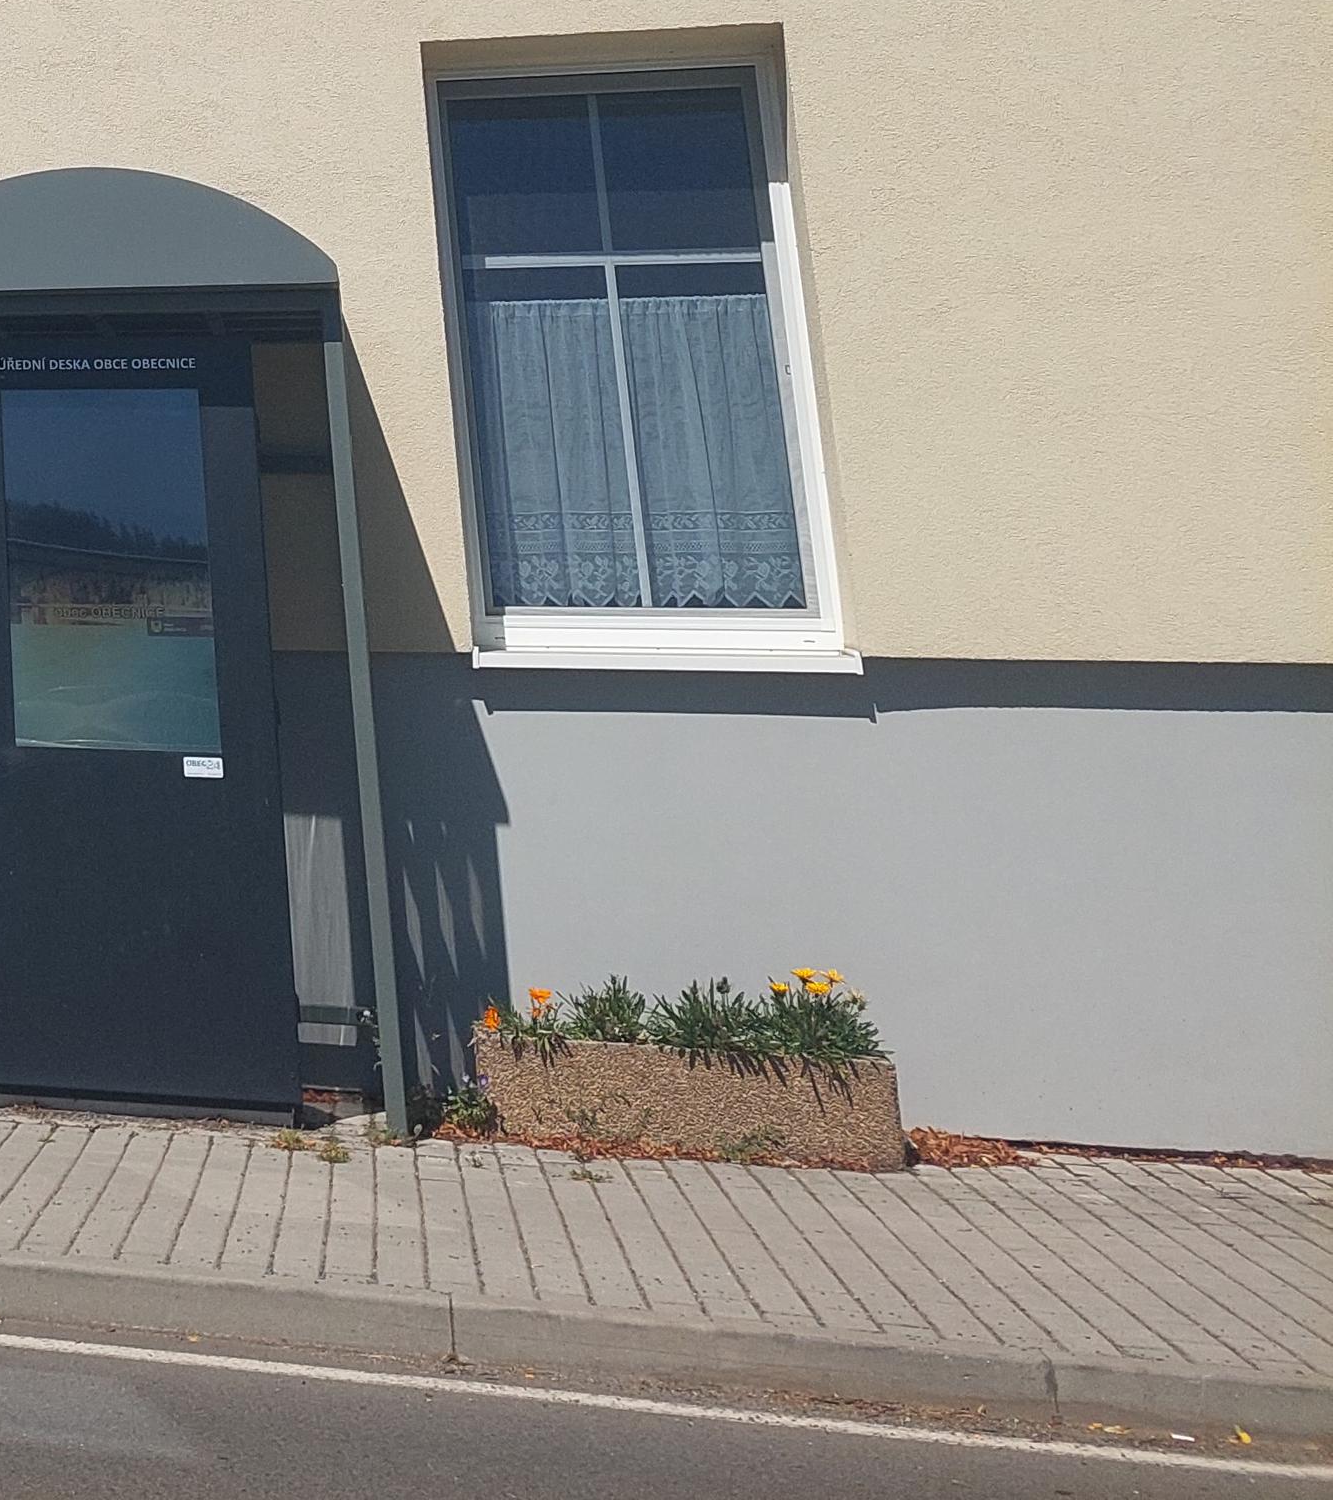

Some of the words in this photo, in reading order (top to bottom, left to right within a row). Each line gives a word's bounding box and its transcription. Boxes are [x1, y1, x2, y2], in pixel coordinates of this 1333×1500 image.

[49, 359, 91, 370] DESKA
[93, 358, 129, 370] OBCE
[132, 357, 197, 370] OBECNICE
